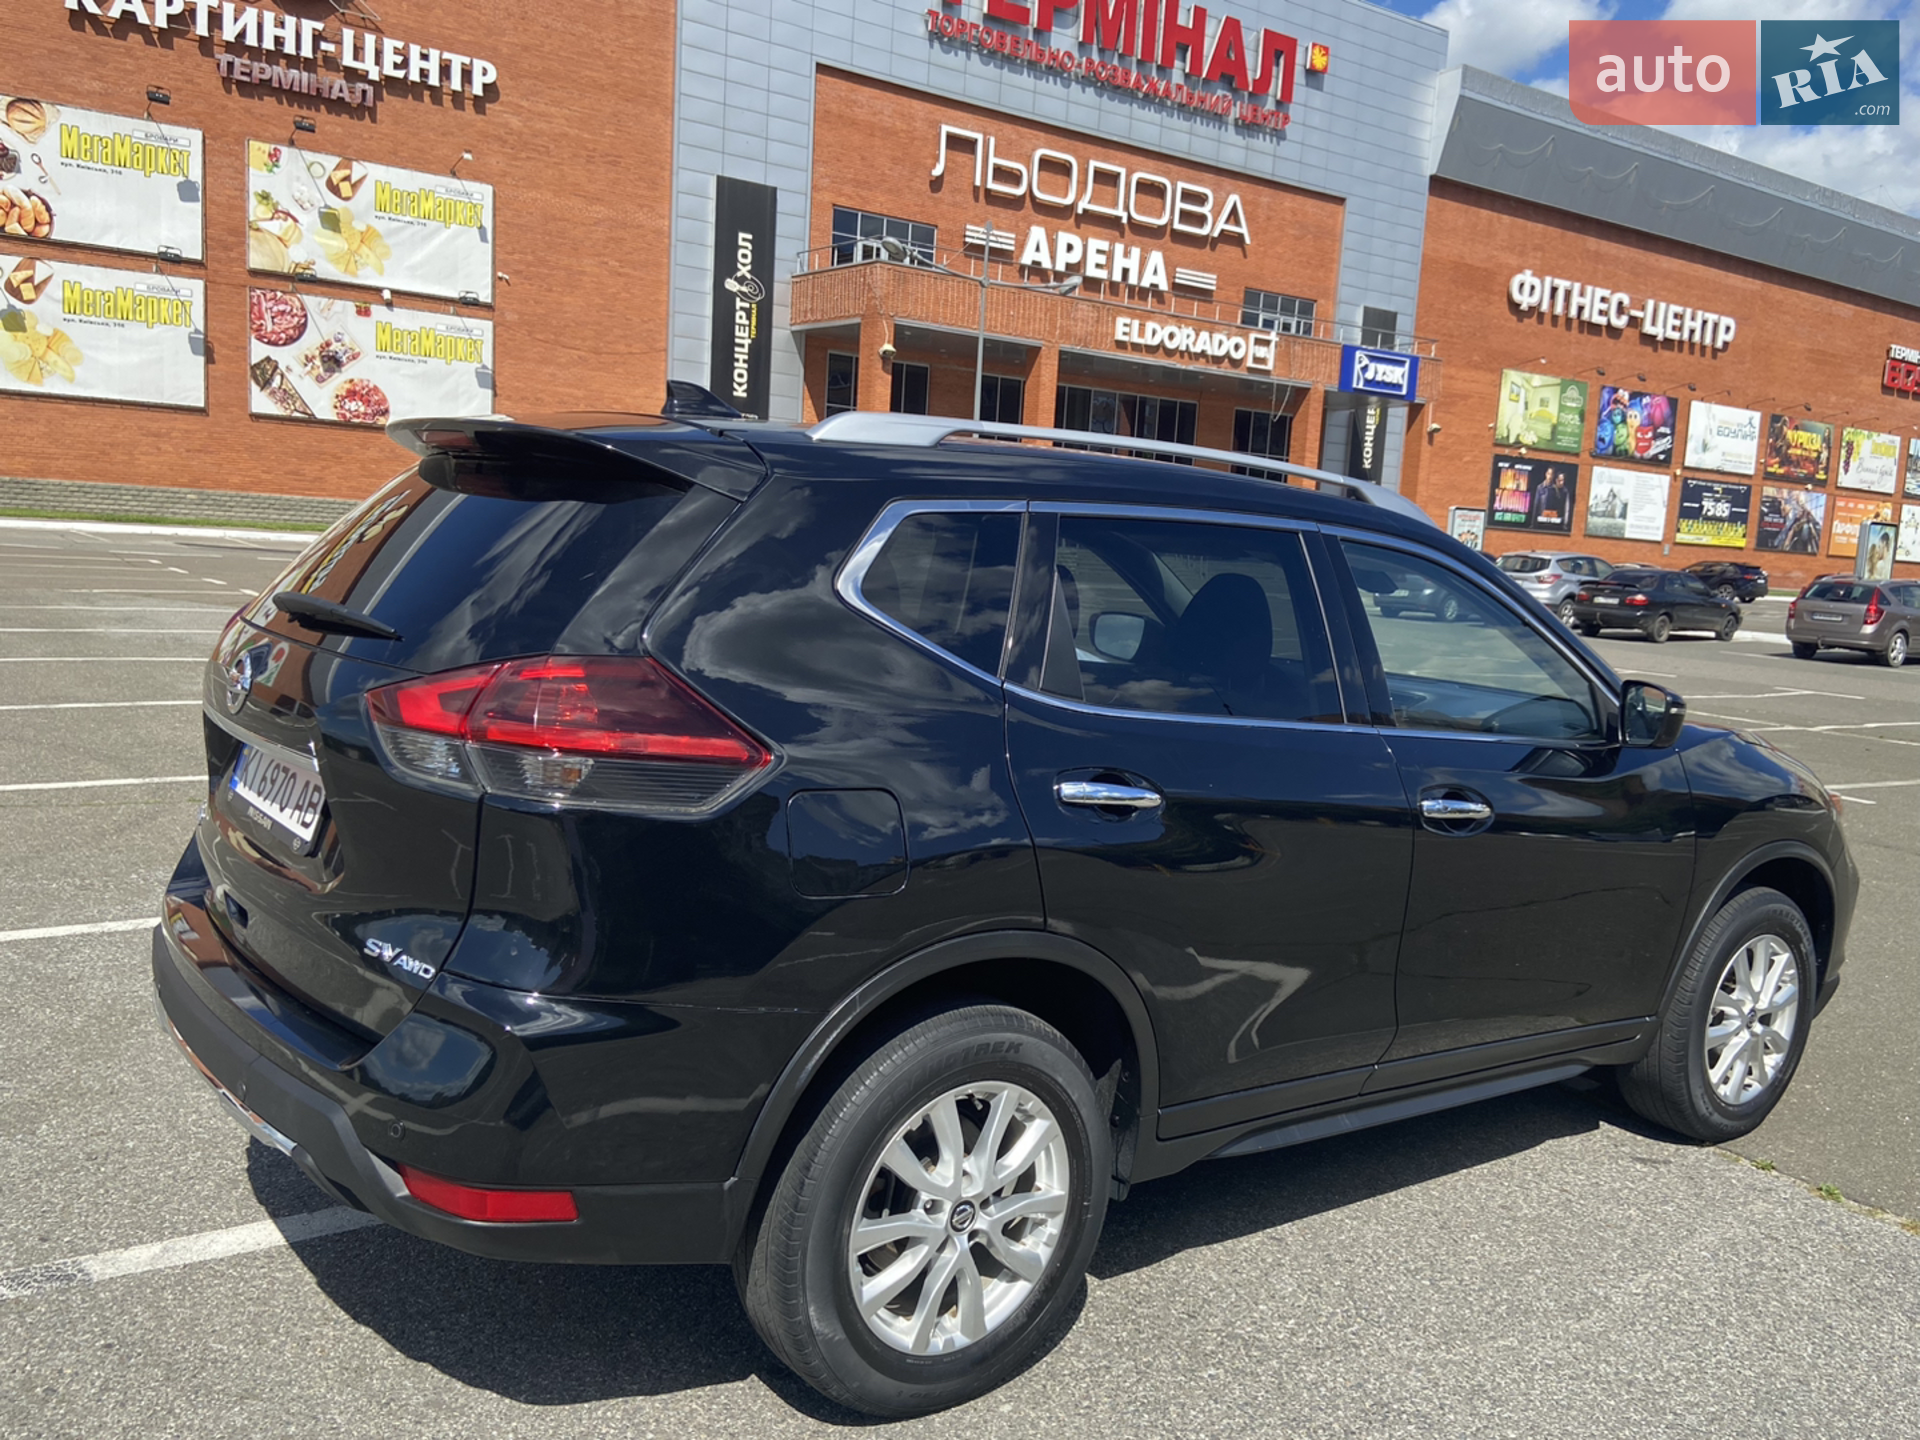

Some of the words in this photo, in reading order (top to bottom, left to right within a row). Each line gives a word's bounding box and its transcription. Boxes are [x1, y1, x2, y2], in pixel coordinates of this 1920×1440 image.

[214, 52, 374, 107] ТЕРМІНАЛ
[1235, 102, 1292, 130] ЦЕНТР
[60, 123, 191, 178] МегаМаркет
[375, 179, 484, 229] МегаМаркет
[931, 124, 1251, 245] ЛЬОДОВА
[736, 231, 754, 279] ХОЛ
[1020, 225, 1169, 291] АРЕНА
[62, 279, 193, 329] МегаМаркет
[1509, 269, 1736, 350] ФІТНЕС-ЦЕНТР
[375, 320, 484, 366] МегаМаркет
[732, 297, 751, 398] КОНЦЕРТ
[1114, 316, 1246, 360] ELDORADO
[1364, 362, 1405, 385] JYSK
[1362, 405, 1377, 469] КОНЦЕР
[256, 758, 298, 814] 6970
[289, 779, 322, 830] AB
[363, 937, 403, 963] SV
[393, 954, 436, 980] AWD
